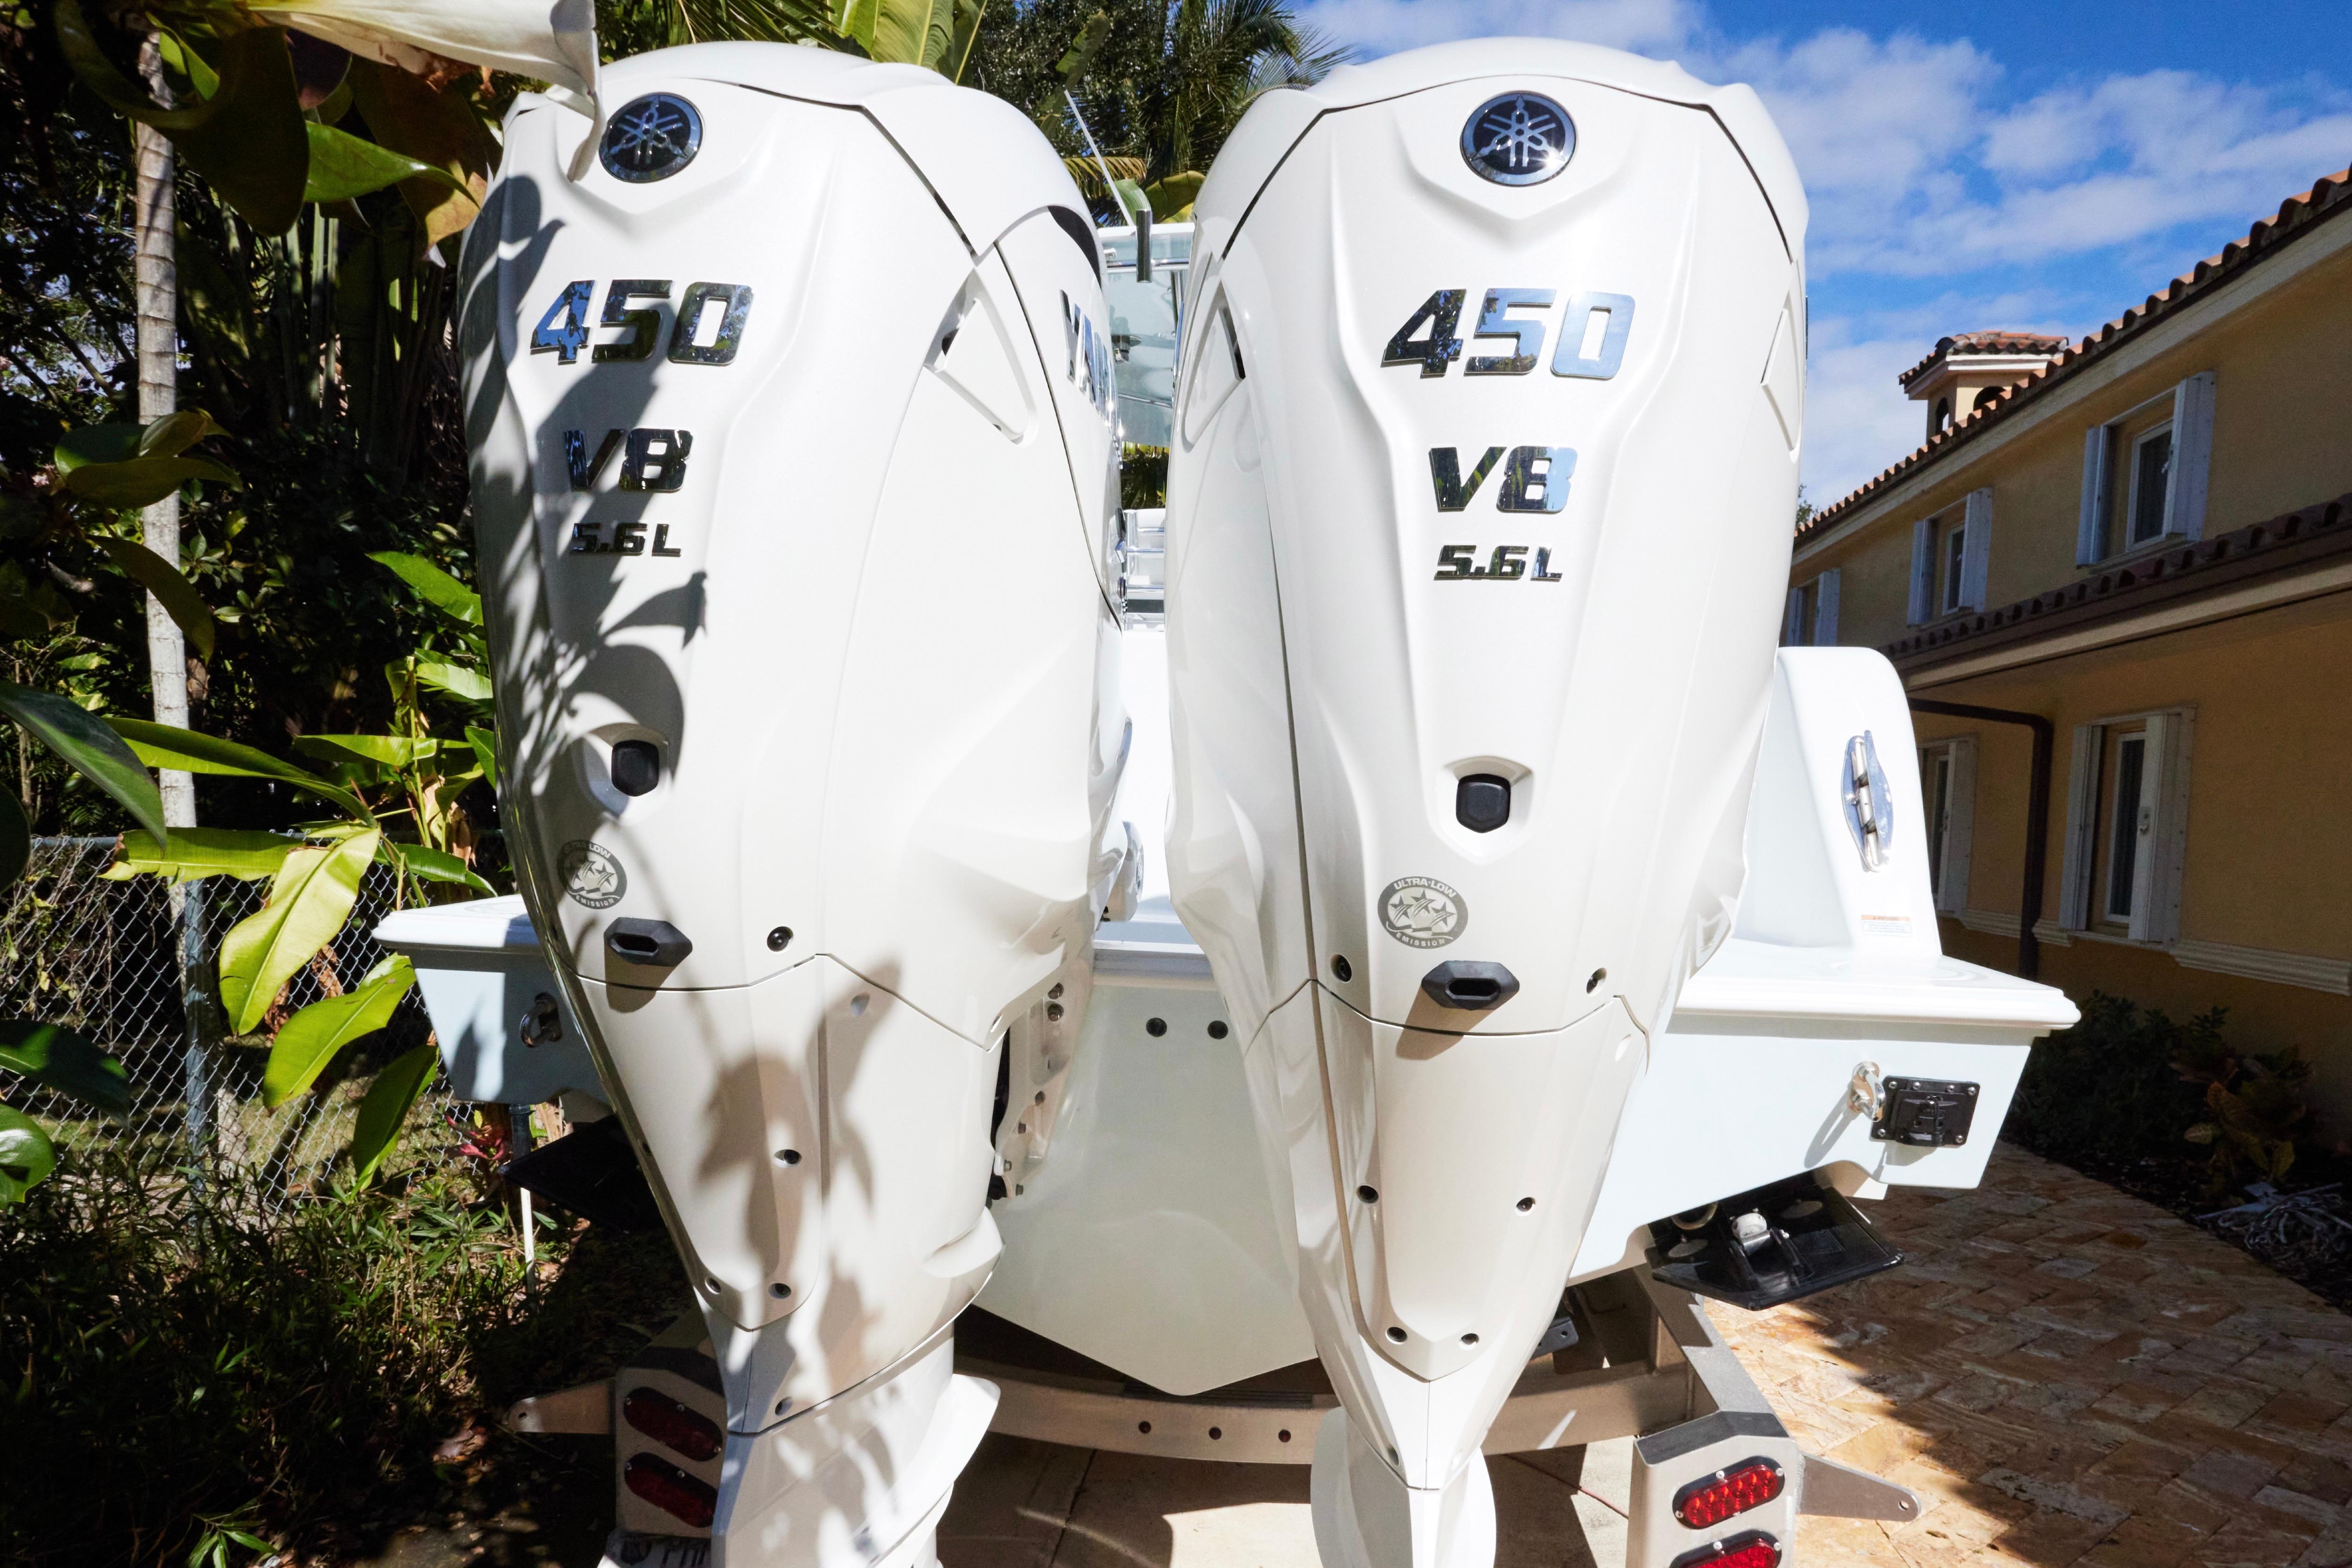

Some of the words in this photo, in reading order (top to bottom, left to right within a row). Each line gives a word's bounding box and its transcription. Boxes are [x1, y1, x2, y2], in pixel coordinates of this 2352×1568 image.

[530, 280, 754, 366] 450
[1381, 288, 1636, 380] 450
[564, 428, 694, 493] V8
[1429, 445, 1578, 515] V8
[570, 523, 681, 557] 5.6L
[1434, 545, 1563, 582] 5.6L
[575, 894, 614, 907] EMISSION
[1395, 932, 1445, 947] EMISSION
